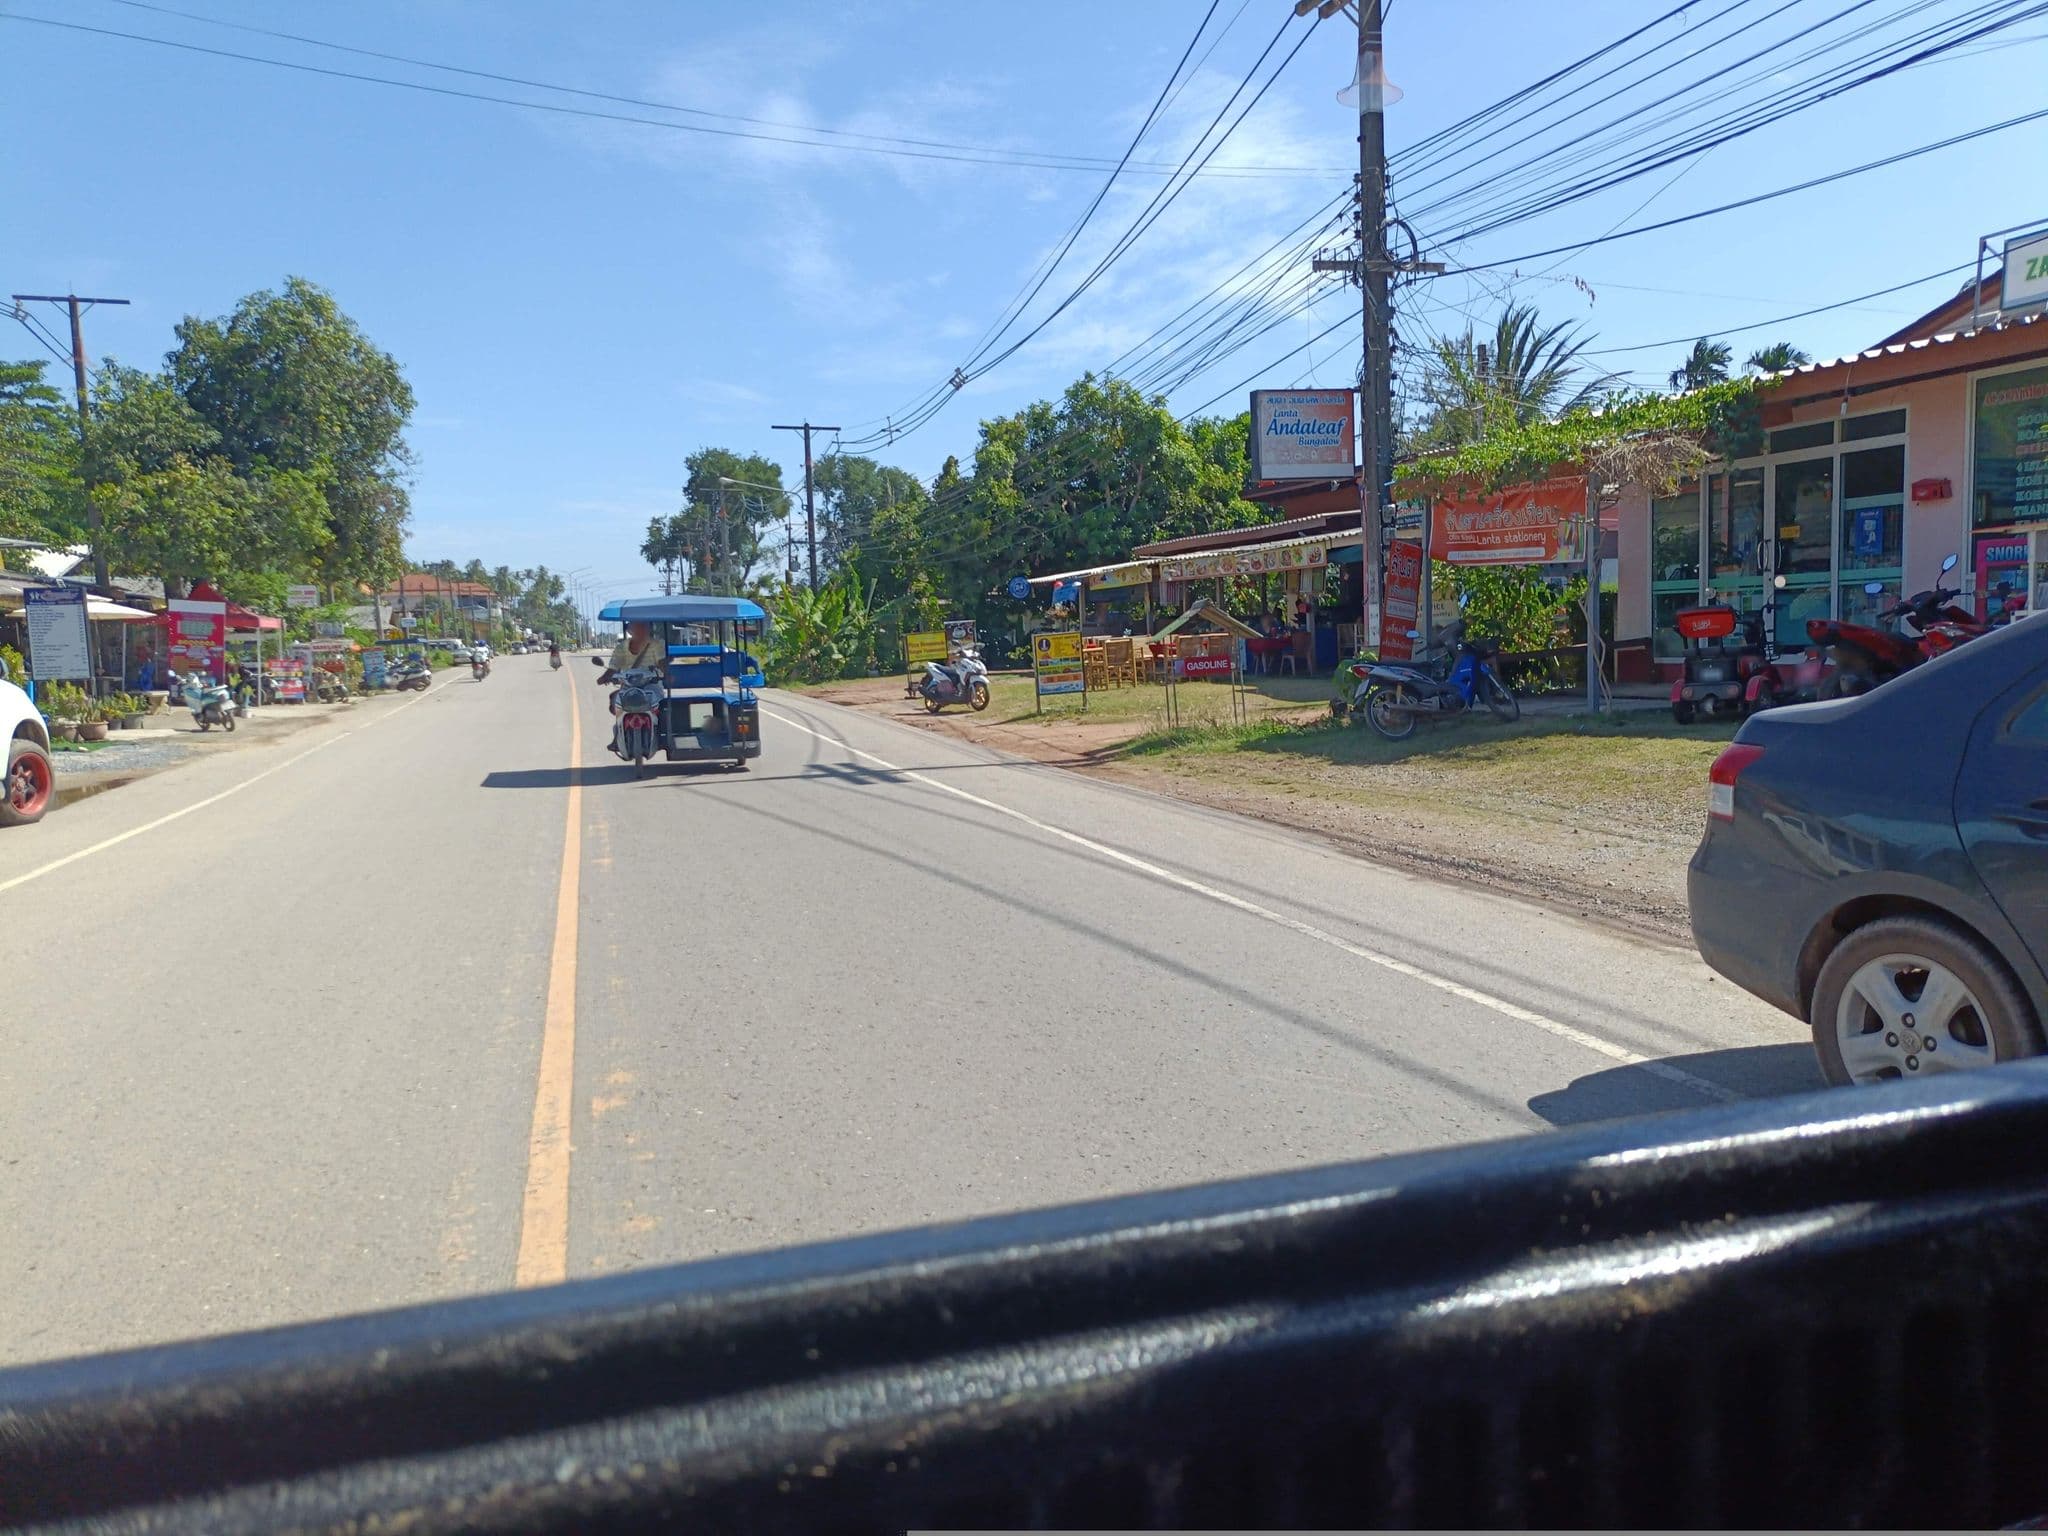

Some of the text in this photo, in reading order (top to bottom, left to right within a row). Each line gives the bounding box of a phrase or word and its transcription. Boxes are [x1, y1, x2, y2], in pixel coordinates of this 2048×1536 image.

[1274, 409, 1298, 418] Lanta
[1266, 418, 1347, 436] Andaleaf
[1298, 437, 1340, 447] Bungalow
[1477, 533, 1500, 545] Lanta
[1504, 531, 1547, 545] stationery
[1186, 660, 1229, 671] GASOLINE
